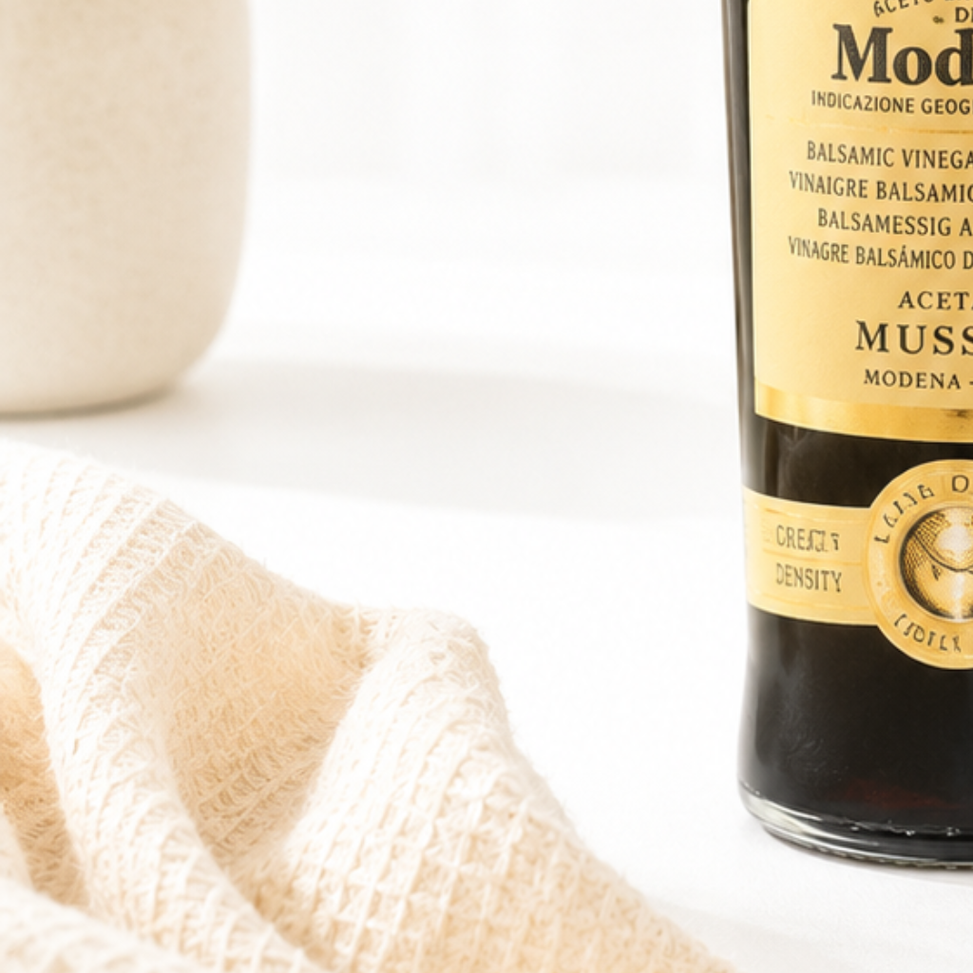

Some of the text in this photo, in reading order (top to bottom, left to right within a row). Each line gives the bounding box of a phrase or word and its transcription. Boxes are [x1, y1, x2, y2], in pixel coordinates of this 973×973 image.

[811, 90, 915, 114] INDICAZIONE
[807, 140, 895, 167] BALSAMIC
[789, 170, 868, 199] VINAIGRE
[818, 207, 951, 236] BALSAMESSIG
[788, 235, 849, 264] VINAGRE
[856, 244, 956, 270] BALSÁMICO
[864, 368, 961, 390] MODENA
[776, 562, 842, 593] DENSITY
